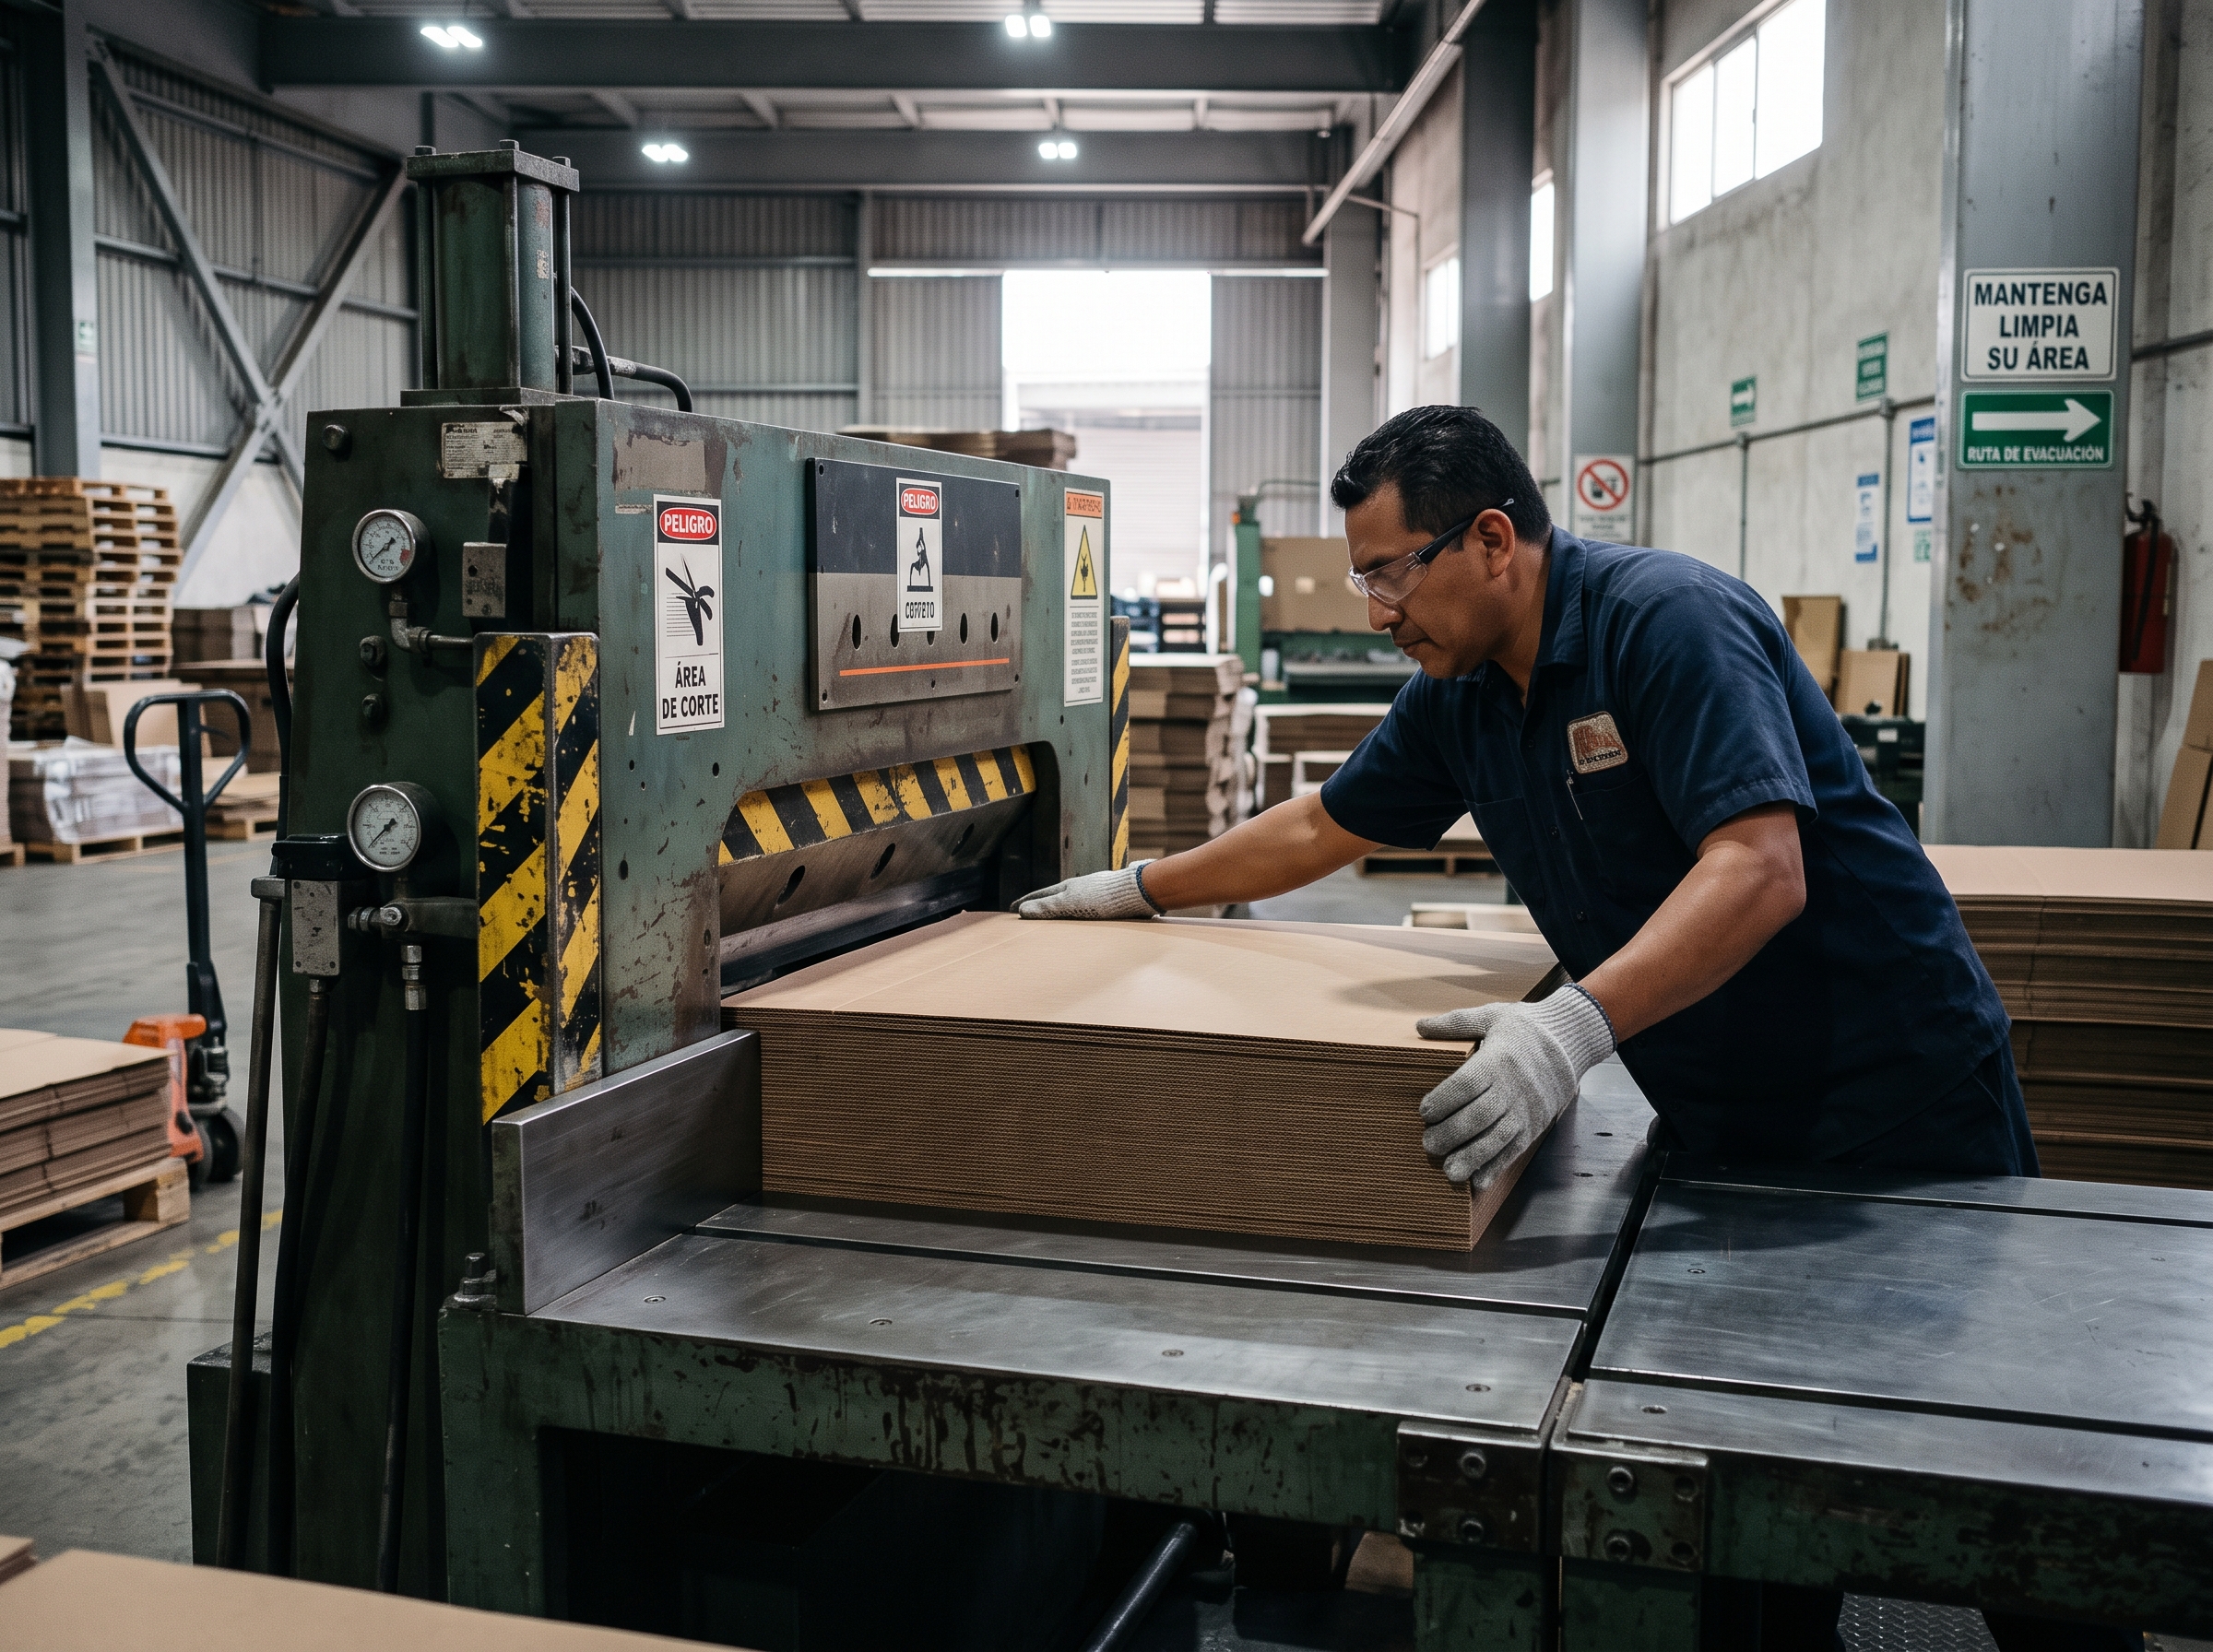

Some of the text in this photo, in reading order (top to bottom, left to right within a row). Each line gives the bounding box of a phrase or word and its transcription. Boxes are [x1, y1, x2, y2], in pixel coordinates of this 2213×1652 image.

[1974, 281, 2108, 306] MANTENGA
[1999, 314, 2079, 338] LIMPIA
[1987, 340, 2089, 371] SU ÁREA
[1967, 444, 2104, 462] RUTA DE EVACUACIÓN
[903, 492, 936, 510] PELIGRO
[664, 513, 714, 535] PELIGRO
[675, 661, 706, 689] ÁREA
[662, 693, 719, 719] DE CORTE
